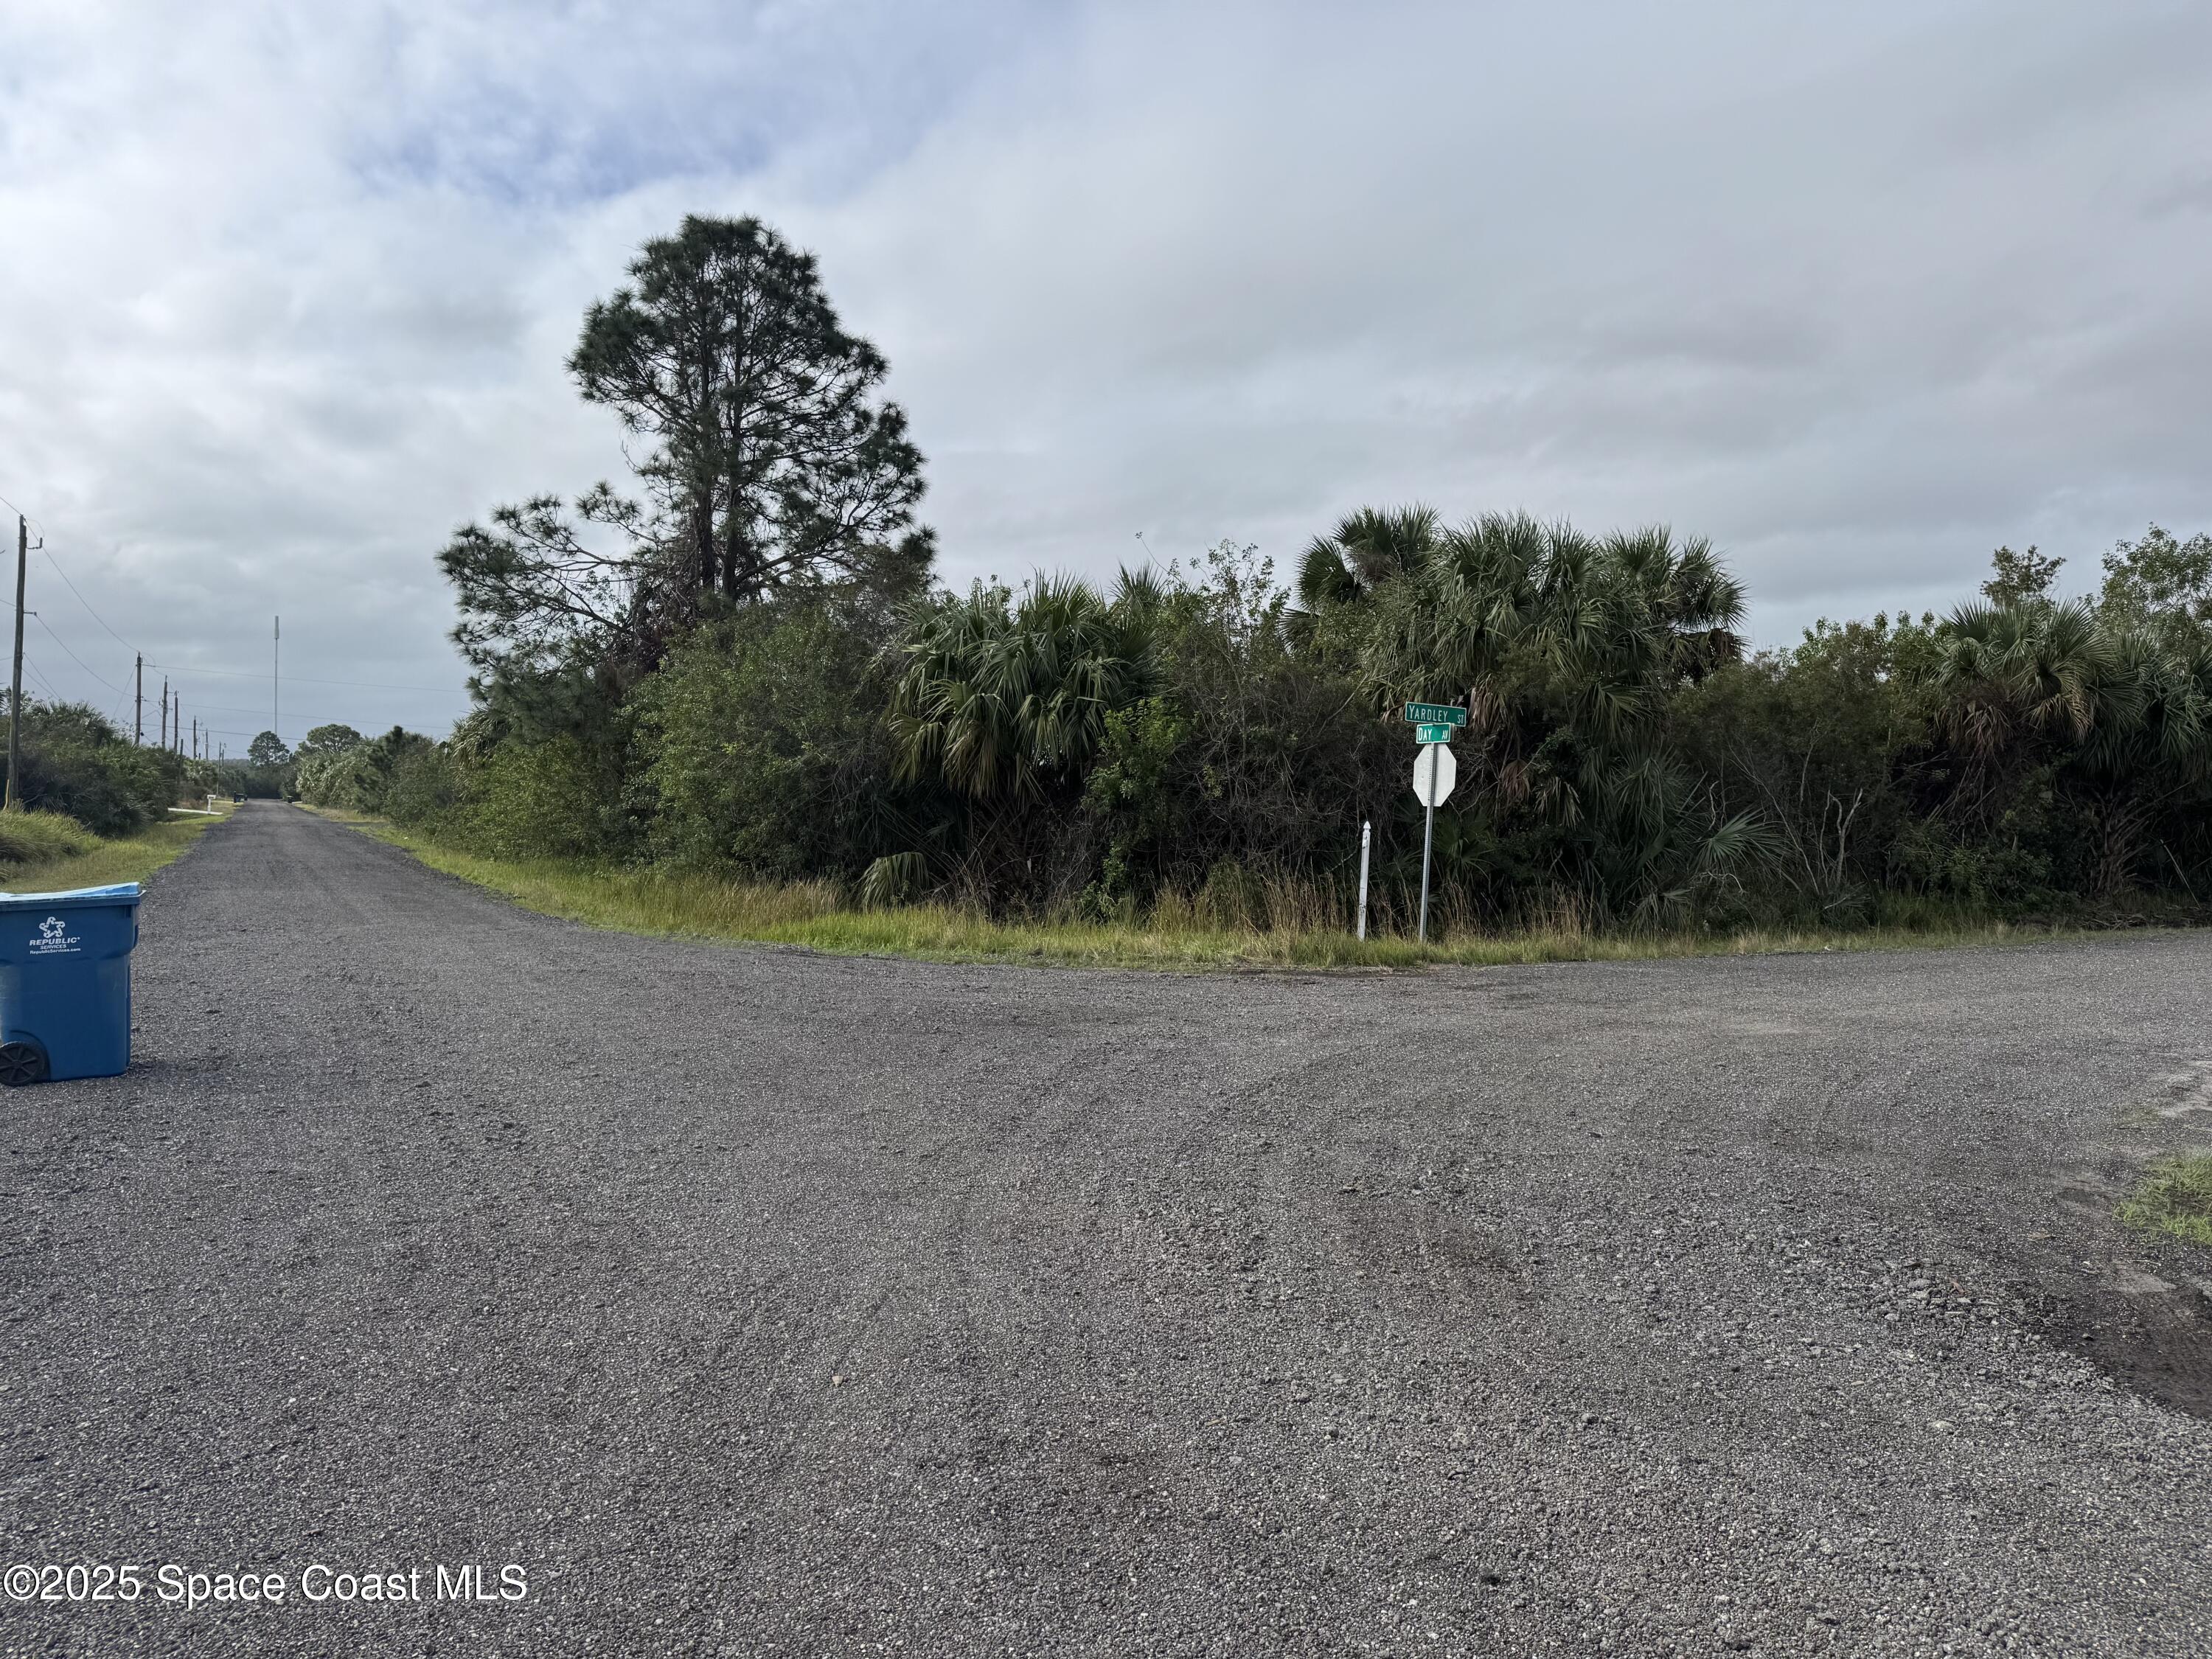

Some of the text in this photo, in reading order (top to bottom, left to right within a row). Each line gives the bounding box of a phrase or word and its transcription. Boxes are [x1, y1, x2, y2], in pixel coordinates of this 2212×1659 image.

[1409, 705, 1464, 724] YARDLEY ST
[1418, 727, 1448, 741] DAY AV
[29, 936, 77, 946] REPUBLIC
